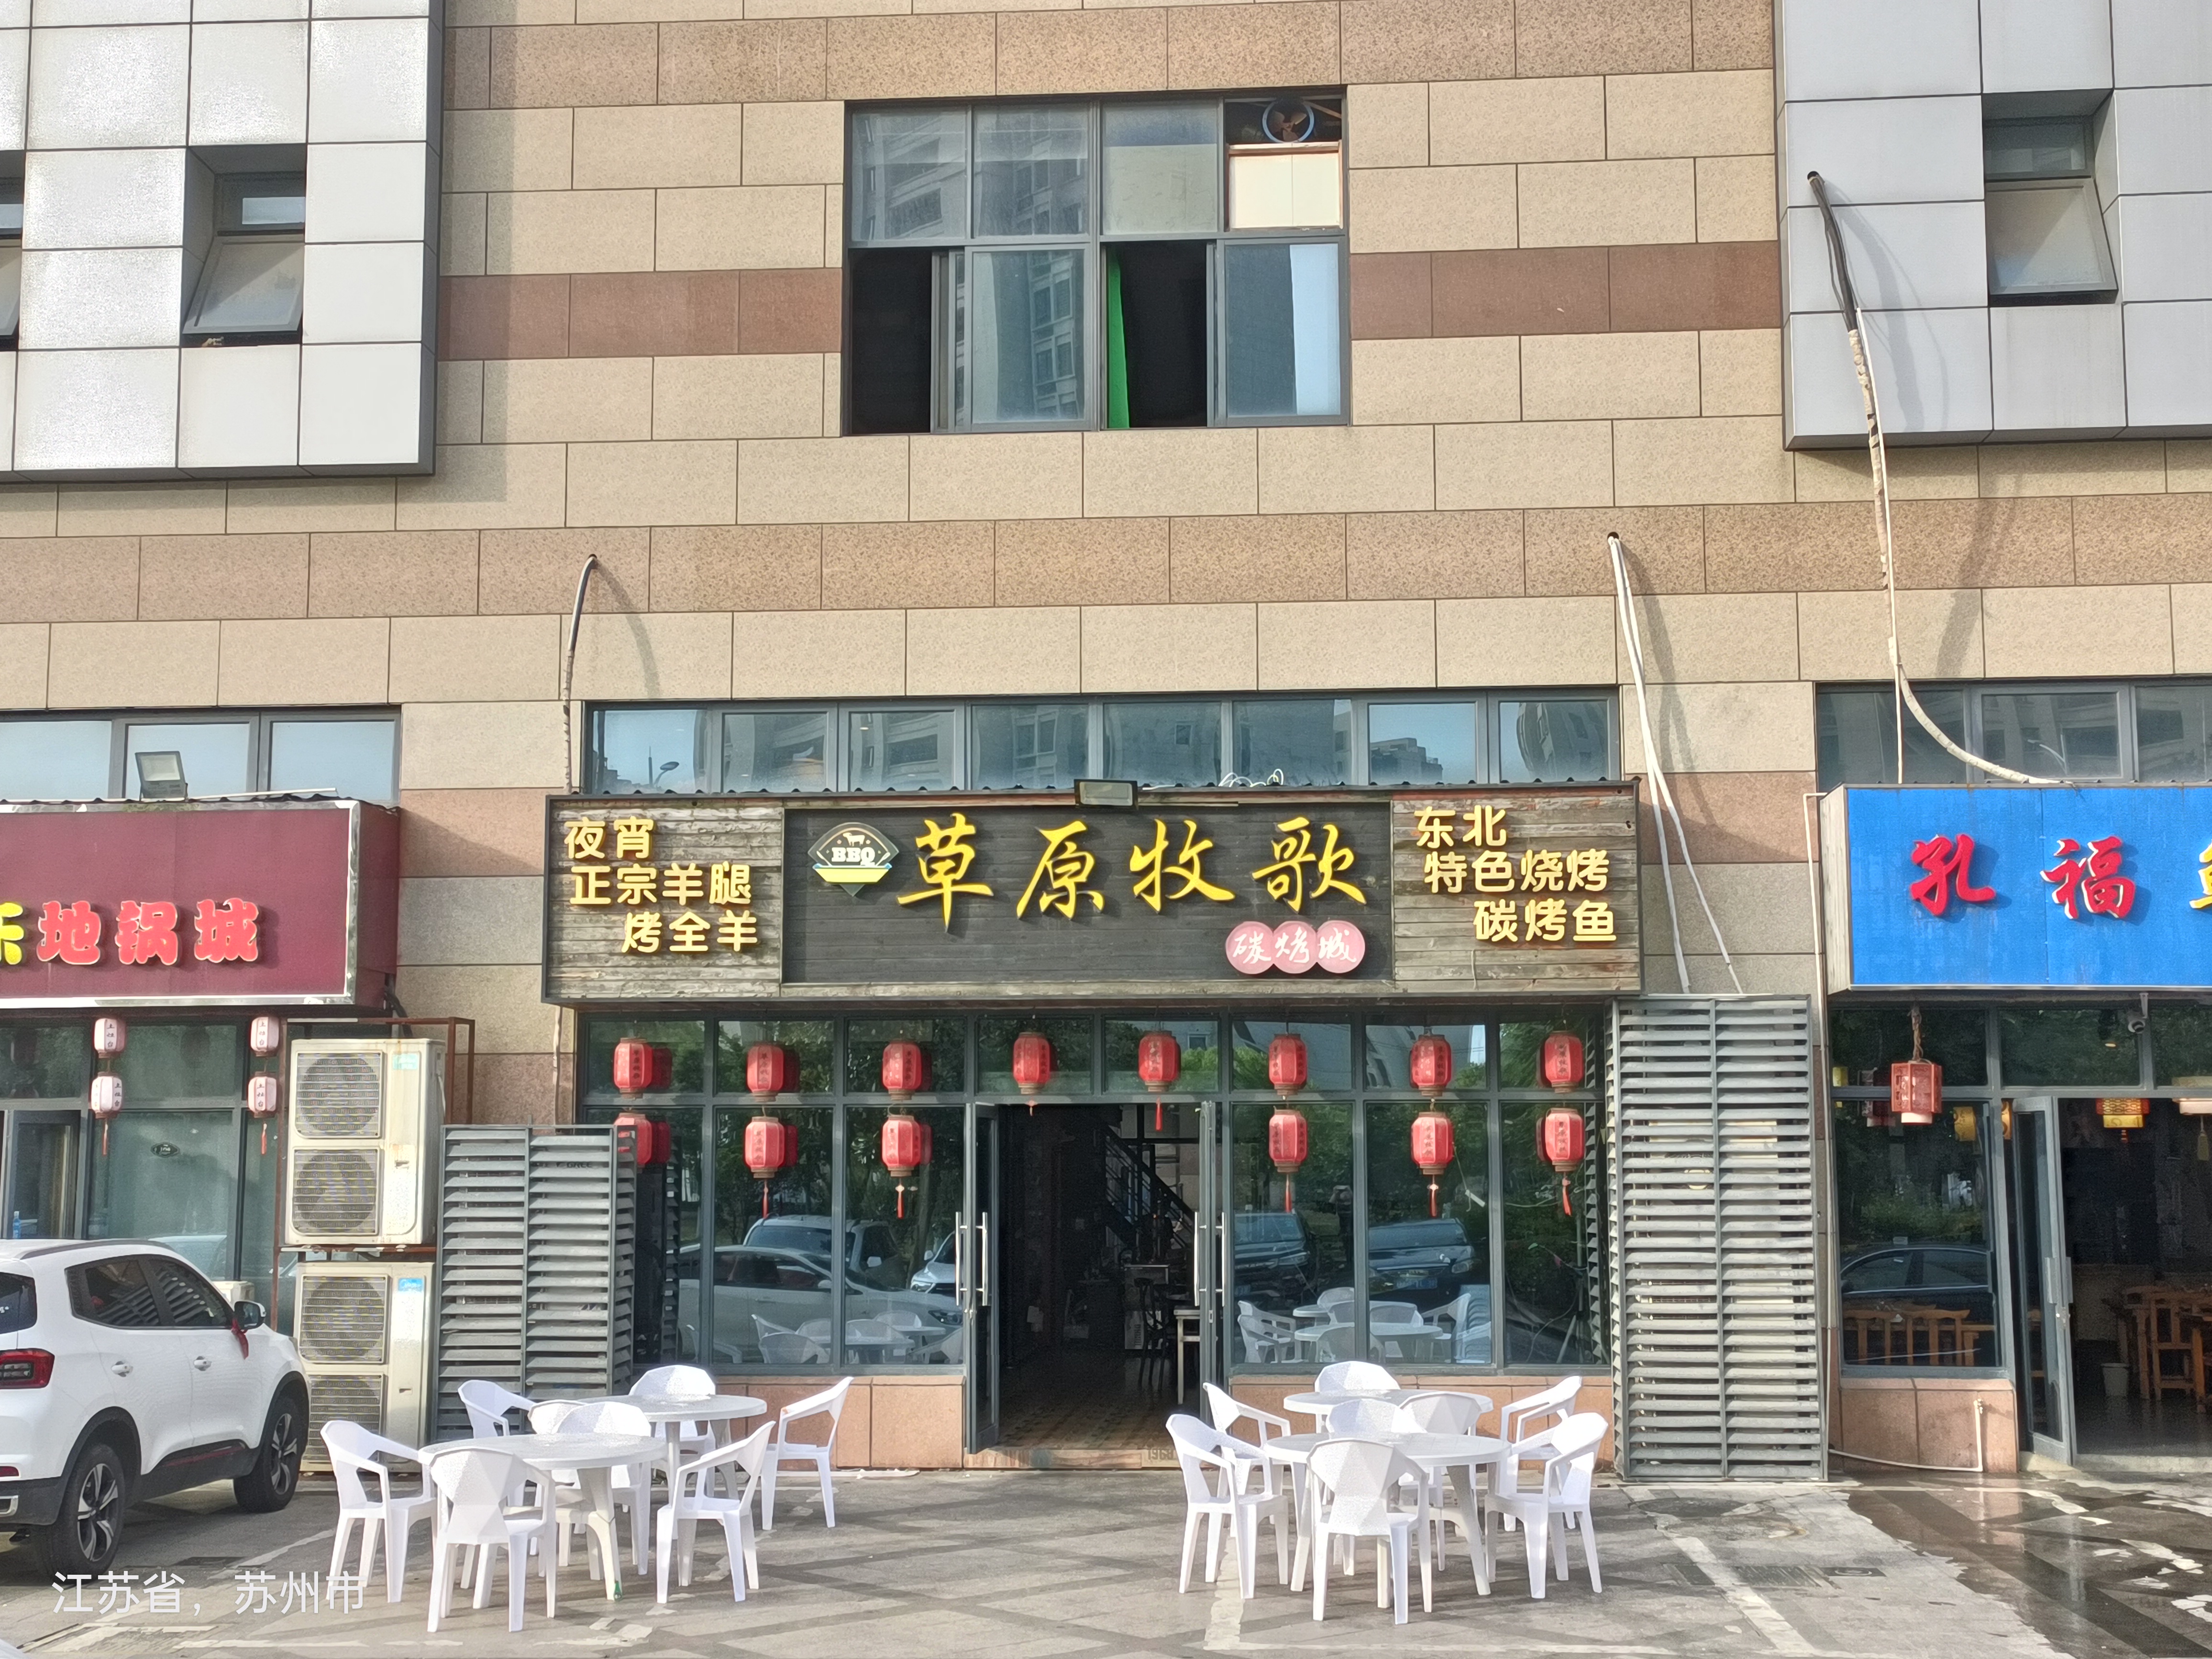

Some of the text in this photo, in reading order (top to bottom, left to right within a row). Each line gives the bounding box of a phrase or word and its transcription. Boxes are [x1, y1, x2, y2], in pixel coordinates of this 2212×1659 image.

[564, 816, 655, 860] 夜宵
[1413, 805, 1508, 849] 东北
[831, 847, 875, 866] BBQ
[896, 812, 1367, 932] 草原牧歌
[1423, 849, 1610, 894] 特色烧烤
[1911, 834, 2212, 919] 孔福
[569, 862, 752, 907] 正宗羊腿
[620, 909, 759, 953] 烤全羊
[1472, 897, 1617, 942] 碳烤鱼
[1233, 926, 1357, 964] 碳烤城
